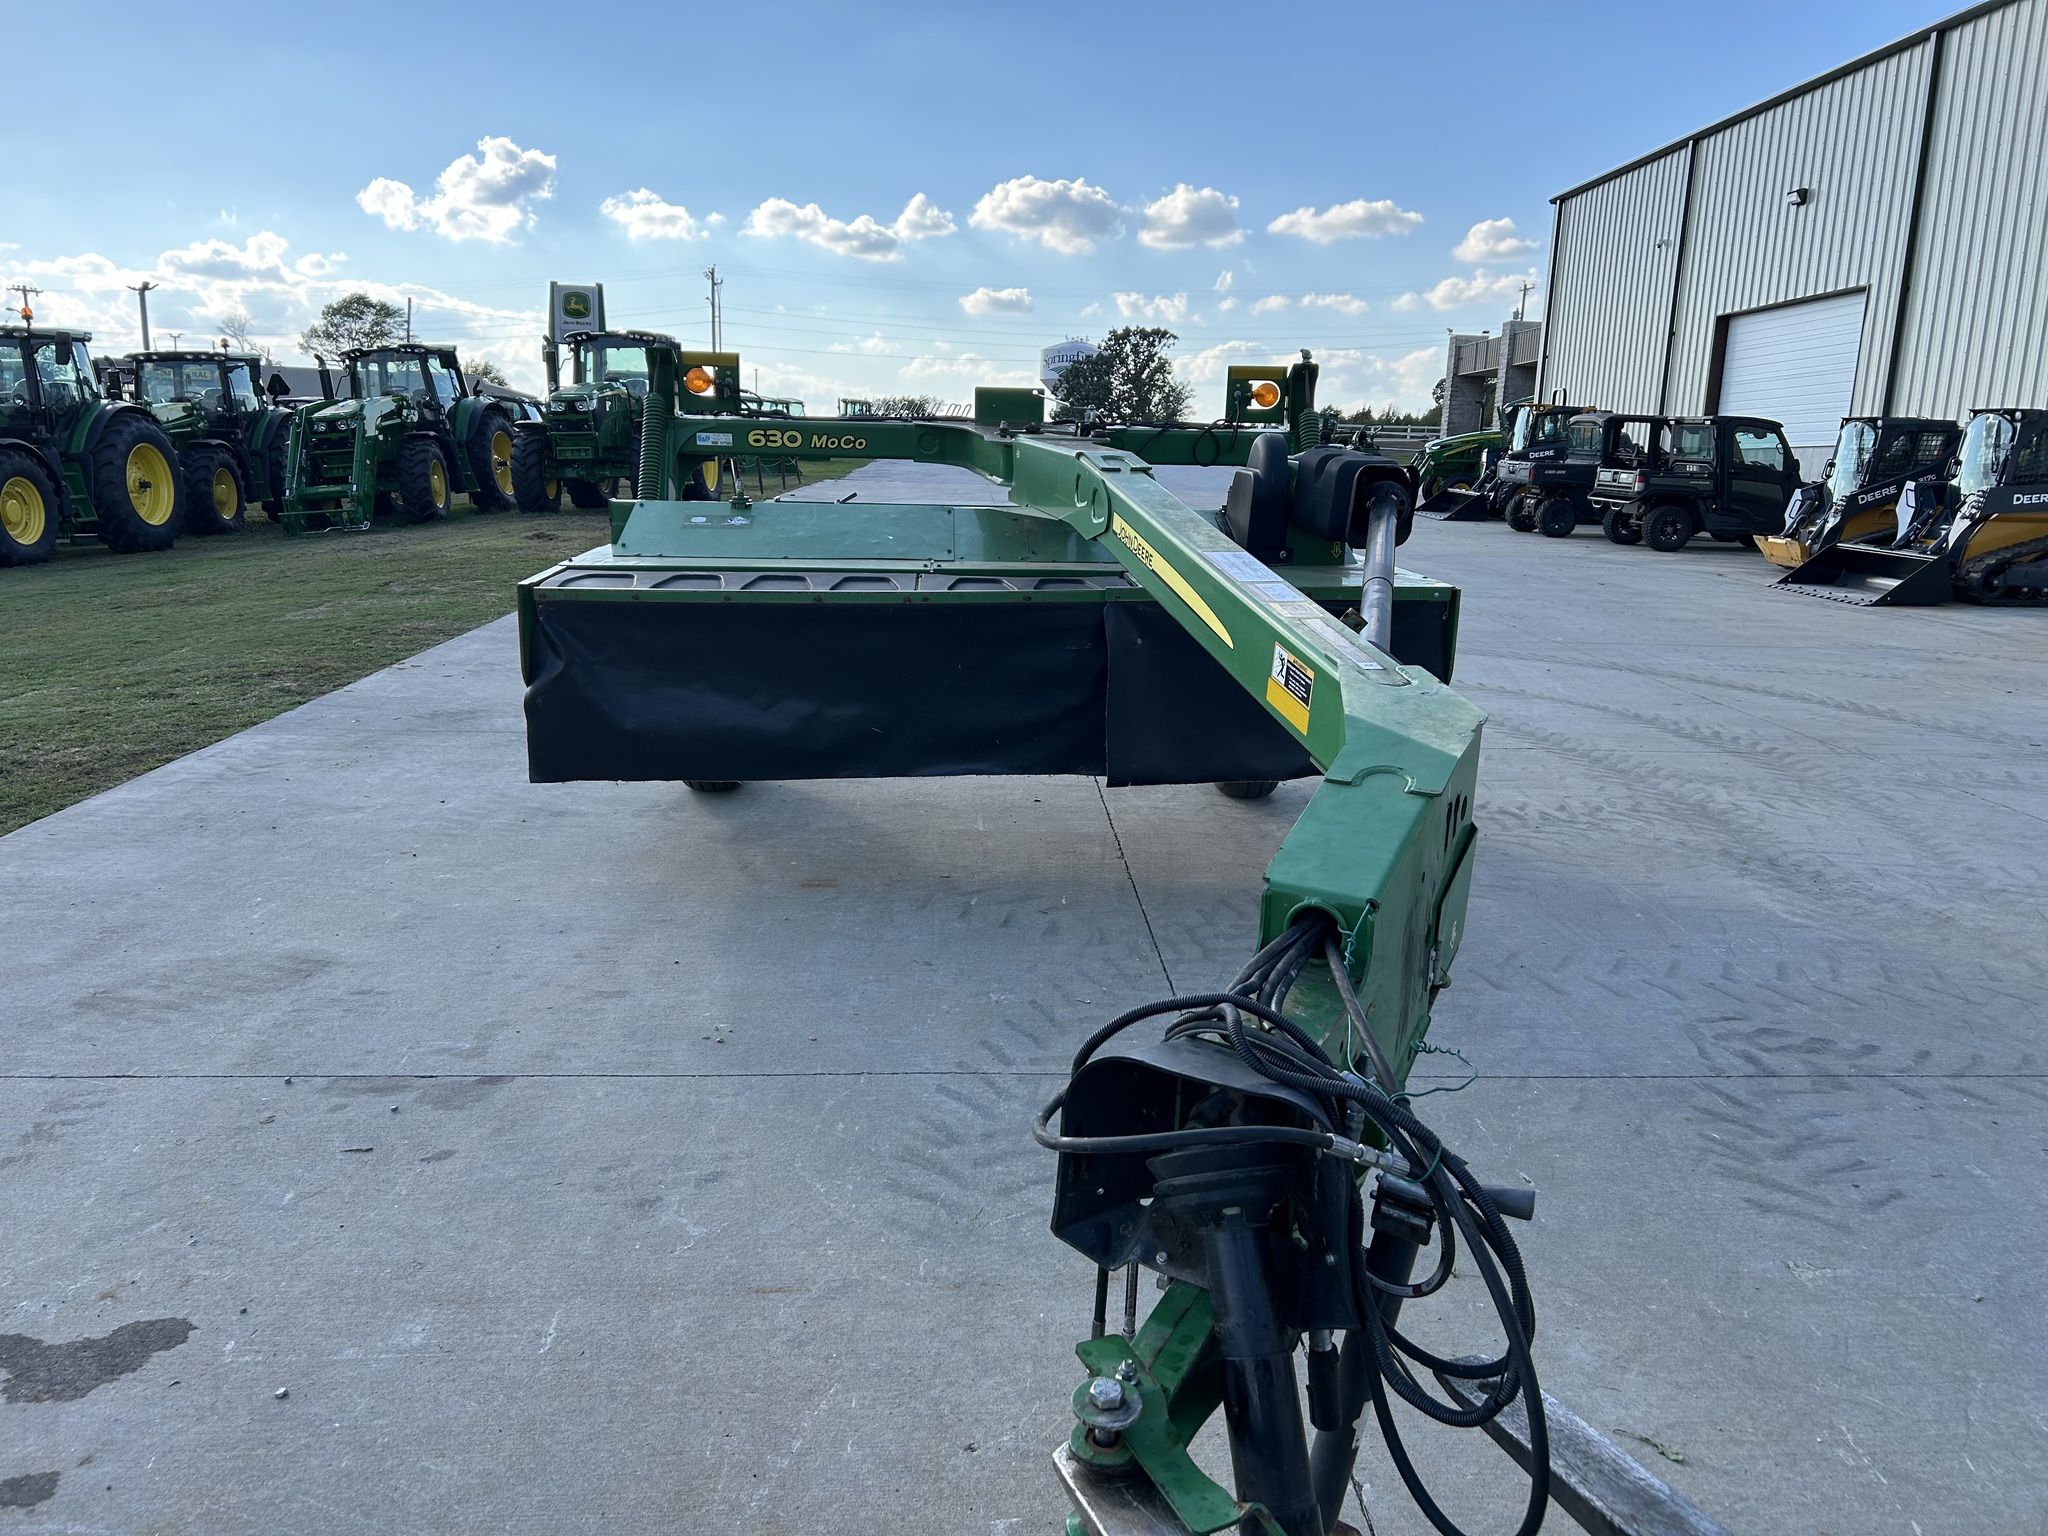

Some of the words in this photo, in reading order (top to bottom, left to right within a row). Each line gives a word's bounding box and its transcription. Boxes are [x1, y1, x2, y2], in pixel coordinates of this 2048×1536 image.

[1043, 350, 1094, 369] Springfi
[747, 429, 803, 448] 630
[810, 434, 867, 450] MoCo
[1529, 450, 1555, 459] DEERE
[1858, 485, 1898, 504] DEERE
[2013, 493, 2048, 504] DEER
[1133, 535, 1154, 568] DEERE
